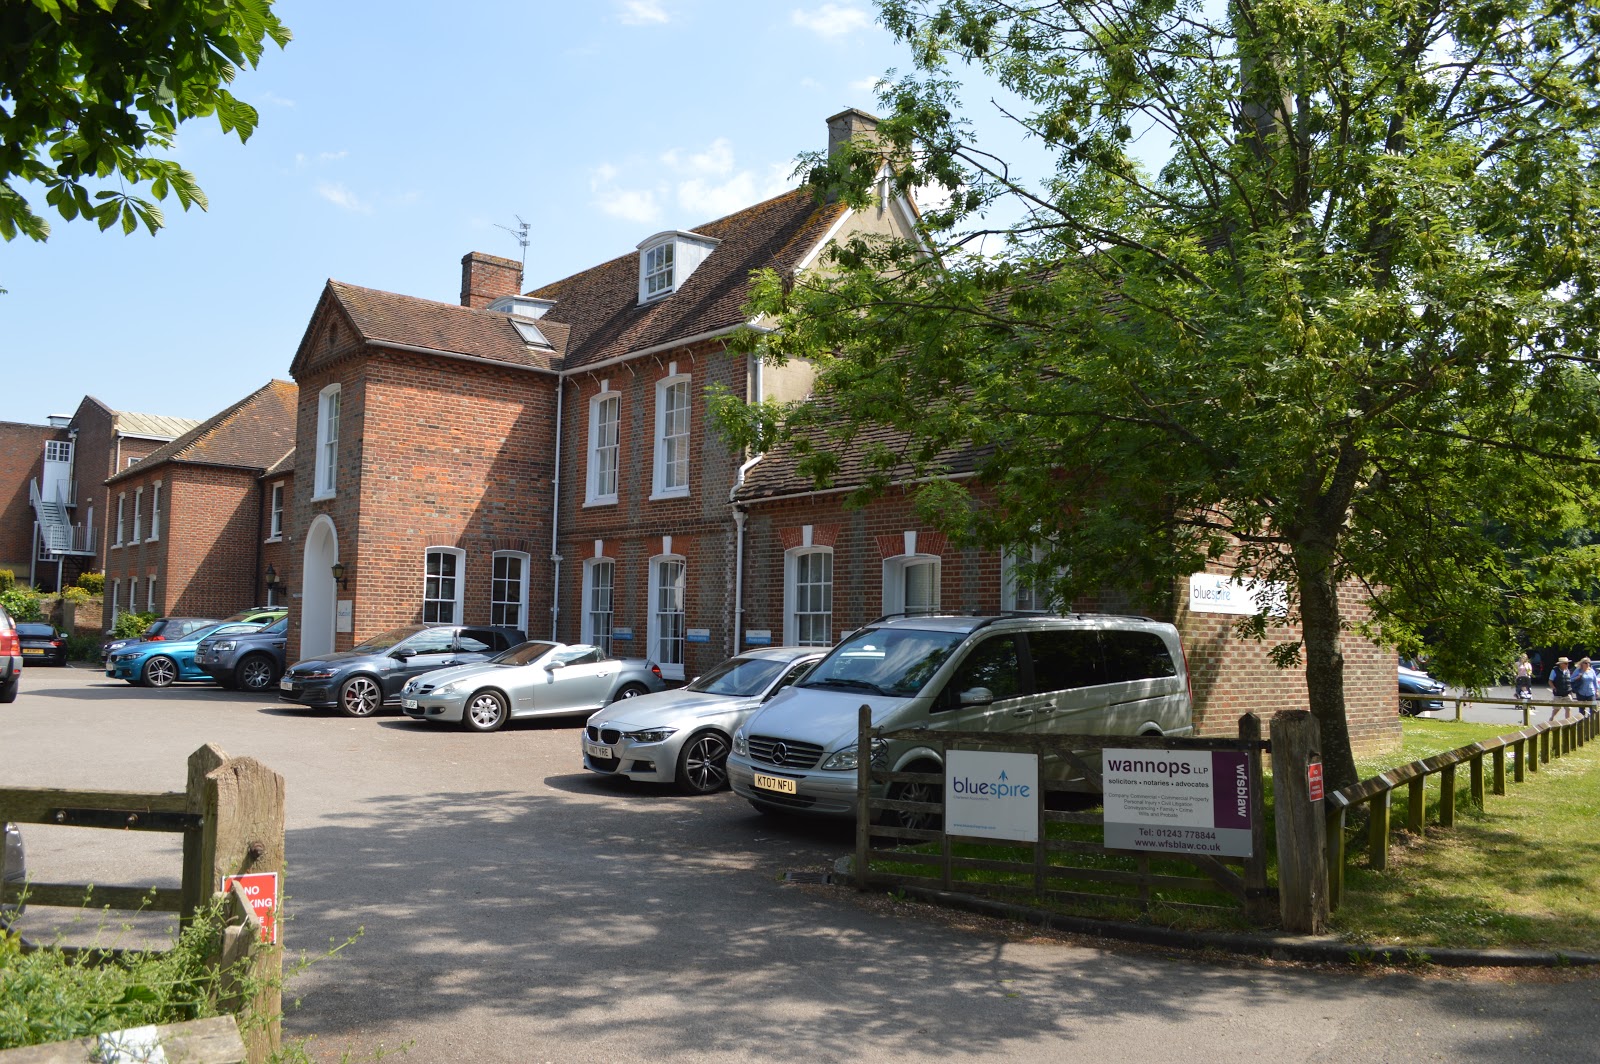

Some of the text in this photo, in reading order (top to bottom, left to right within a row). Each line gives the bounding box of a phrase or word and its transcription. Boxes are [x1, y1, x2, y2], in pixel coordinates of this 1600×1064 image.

[1194, 585, 1230, 602] bluespire
[598, 747, 608, 757] YRE
[1108, 760, 1190, 777] wannops
[758, 776, 793, 791] KT07 NFU
[953, 776, 1030, 799] bluespire
[1236, 764, 1248, 817] wfsblaw
[1139, 828, 1216, 840] Tel: 01243 778844
[1135, 839, 1220, 851] www.wfsblaw.co.uk
[244, 886, 259, 895] NO
[250, 898, 272, 908] KING
